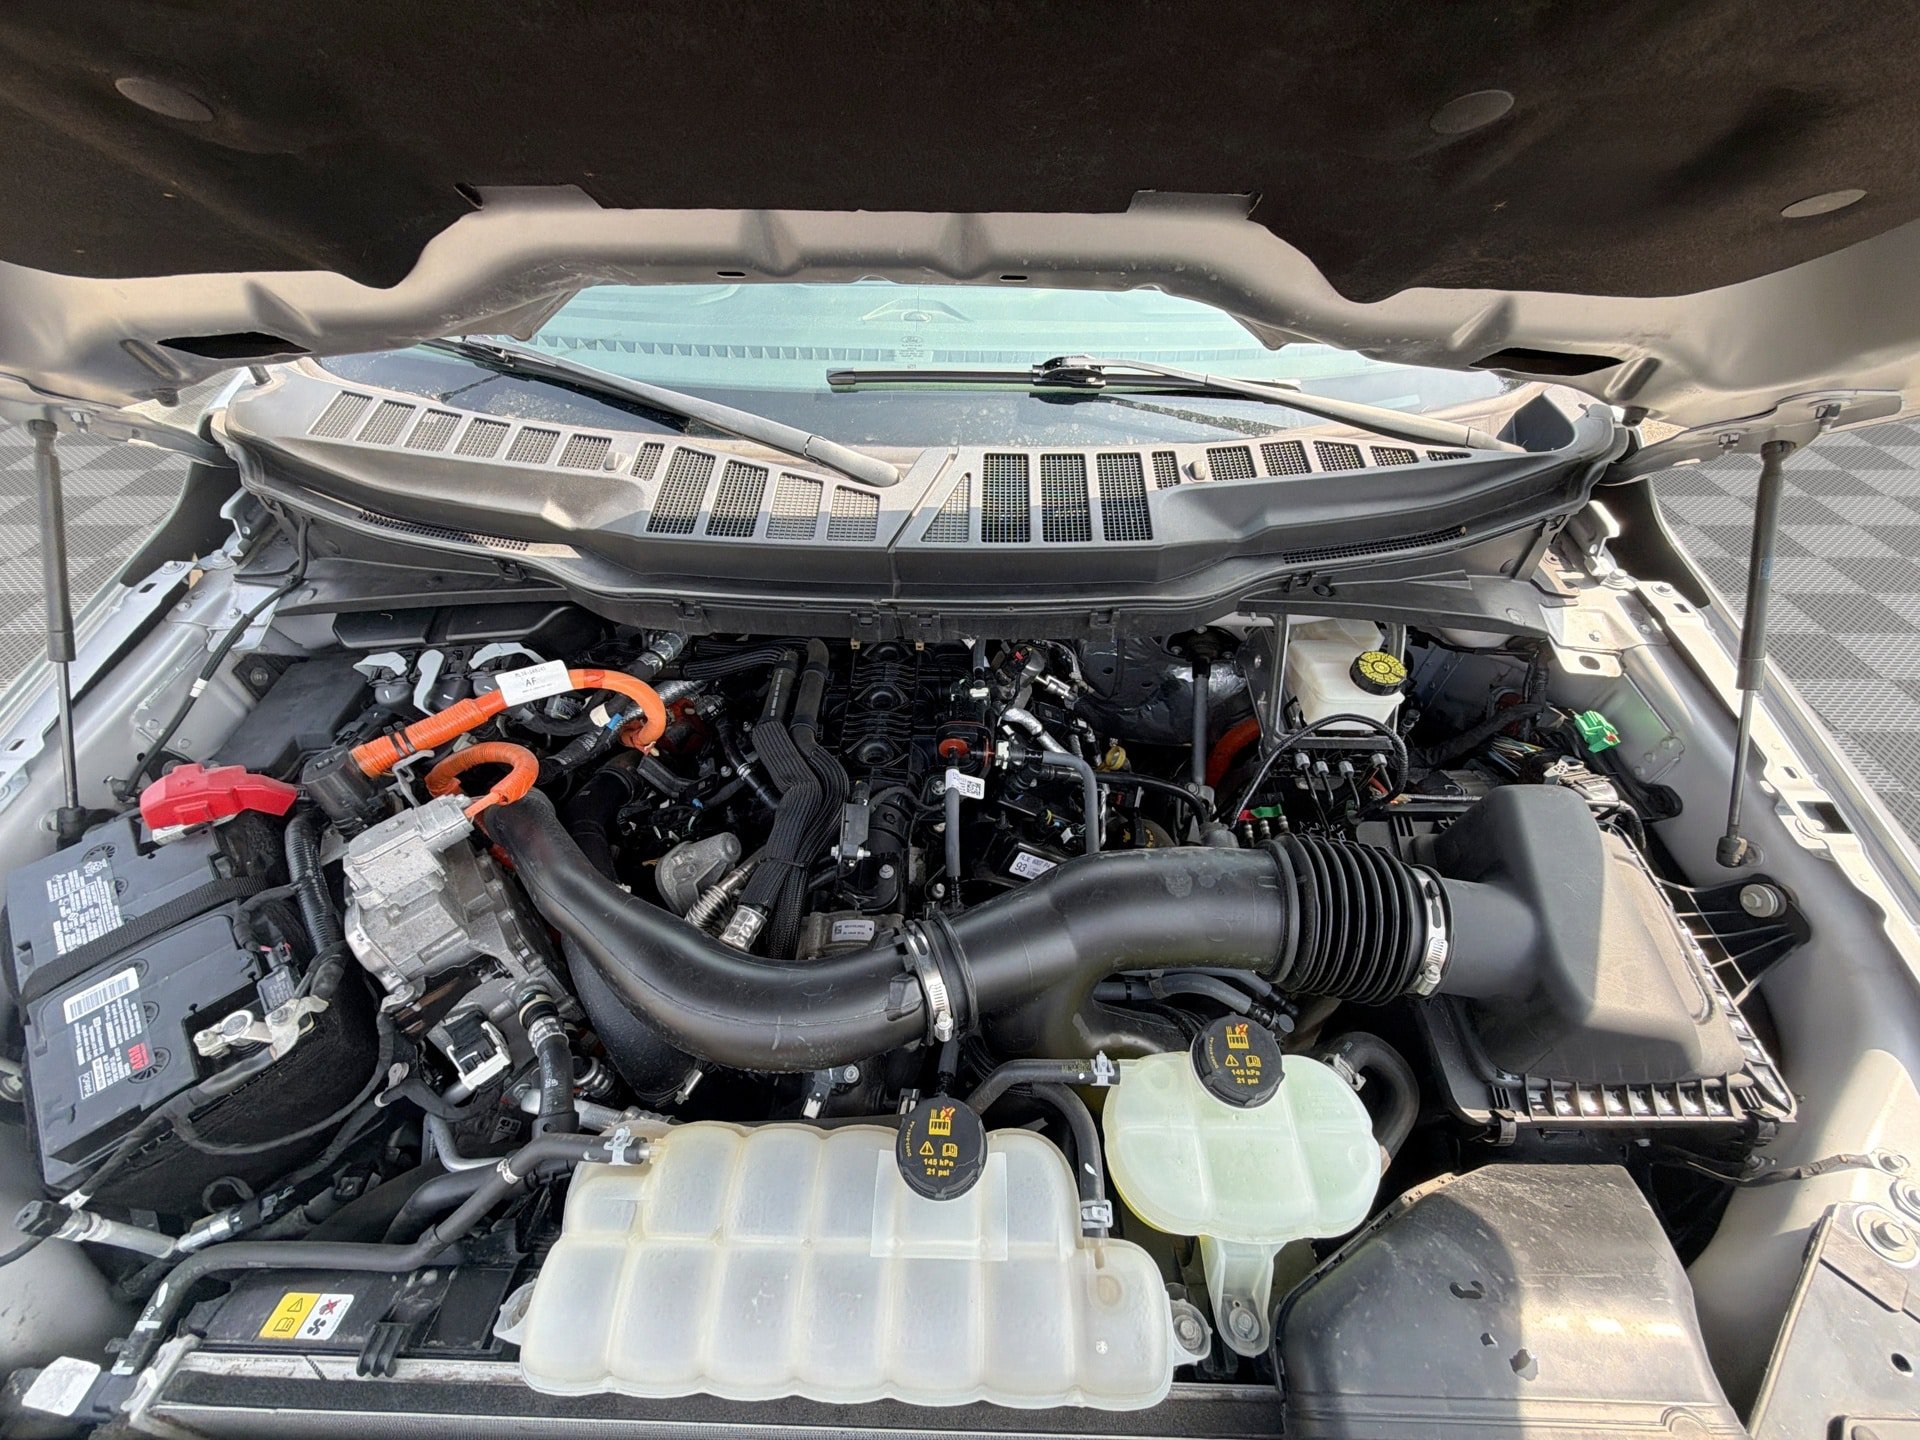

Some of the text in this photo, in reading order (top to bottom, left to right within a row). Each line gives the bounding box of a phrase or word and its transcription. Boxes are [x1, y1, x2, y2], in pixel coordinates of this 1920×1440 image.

[525, 677, 537, 688] AF
[1014, 861, 1027, 873] 93
[127, 1044, 144, 1070] AGM
[1247, 1077, 1259, 1085] psi
[923, 1158, 954, 1167] 145 kPa
[937, 1168, 950, 1178] psi
